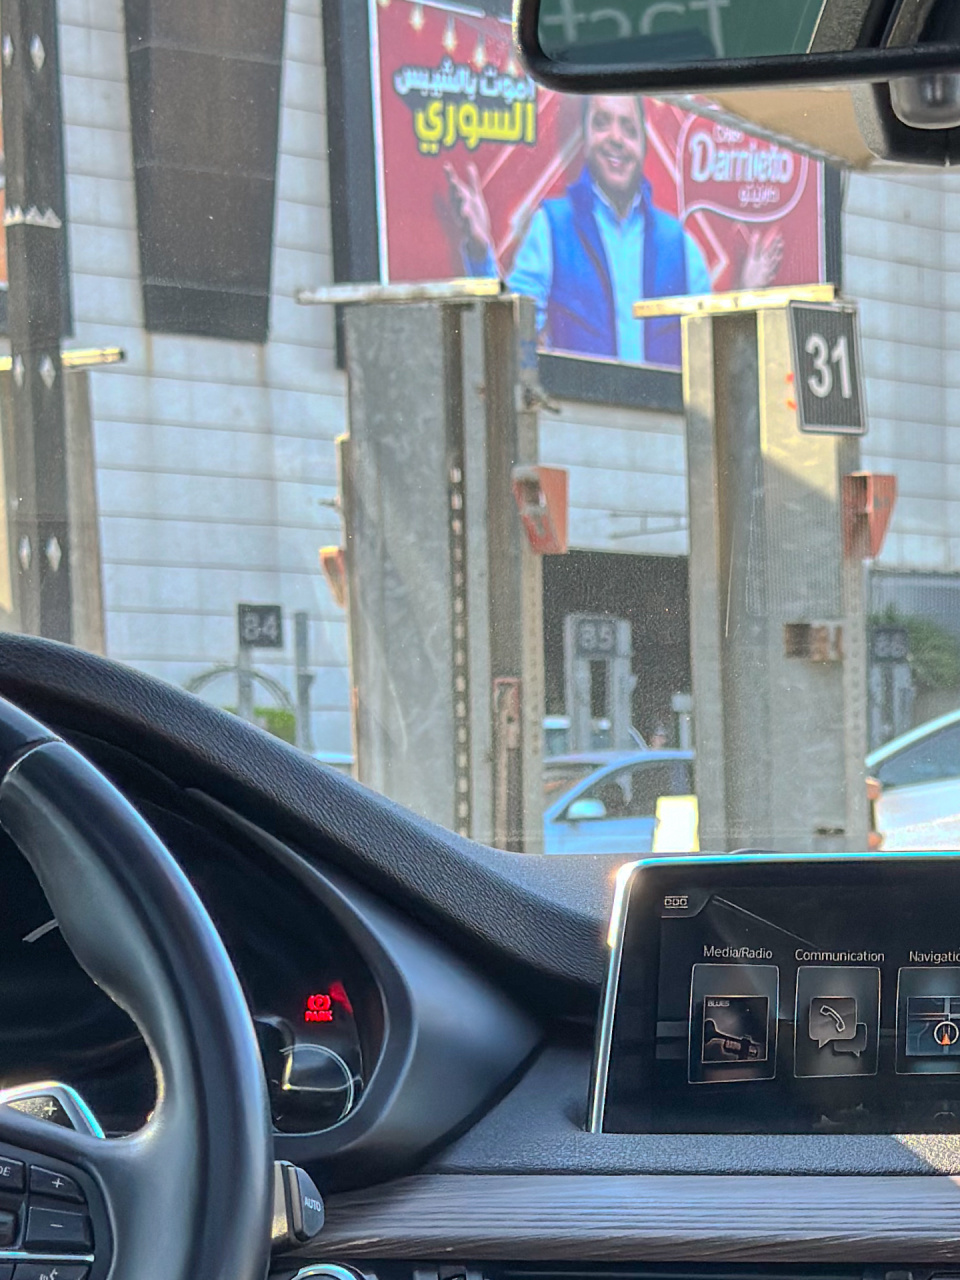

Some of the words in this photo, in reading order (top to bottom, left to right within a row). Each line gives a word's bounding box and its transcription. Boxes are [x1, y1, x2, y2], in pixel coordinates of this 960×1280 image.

[416, 101, 535, 154] السوري
[806, 333, 852, 398] 31
[703, 945, 773, 960] Media/Radio
[795, 949, 885, 962] Communication
[304, 1196, 321, 1212] AUTO
